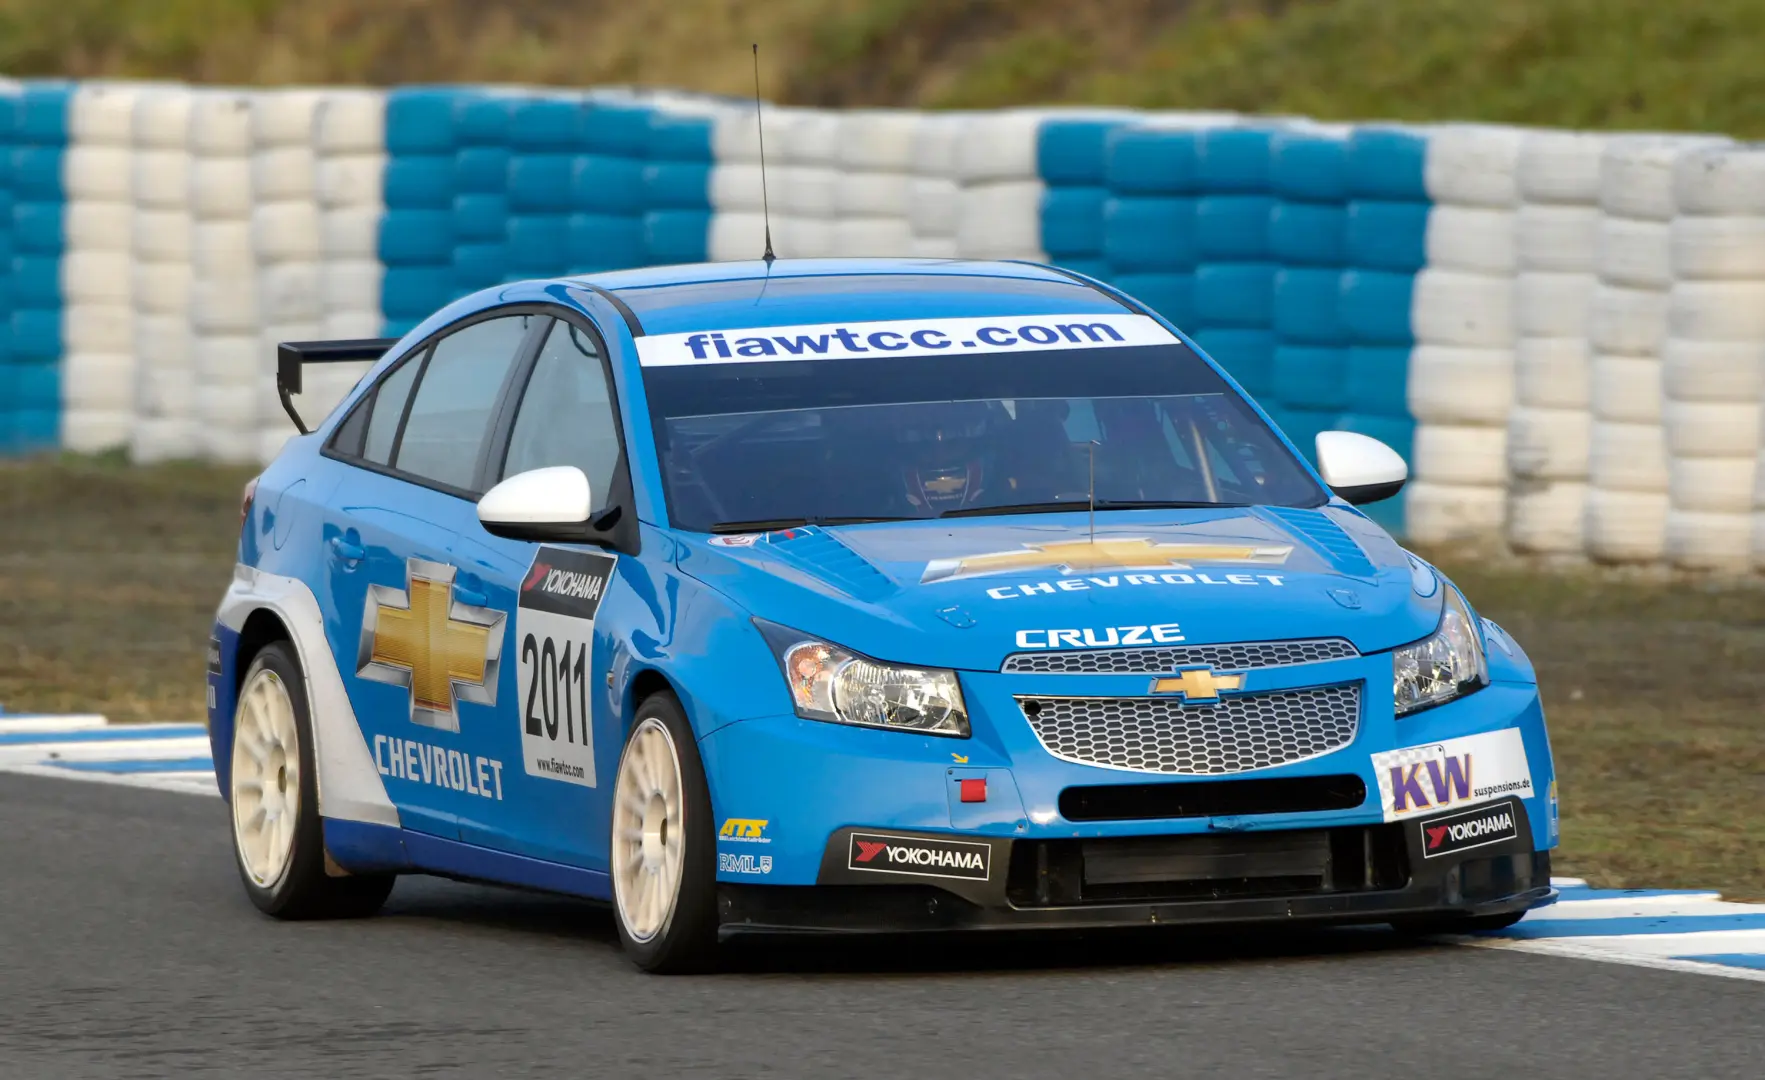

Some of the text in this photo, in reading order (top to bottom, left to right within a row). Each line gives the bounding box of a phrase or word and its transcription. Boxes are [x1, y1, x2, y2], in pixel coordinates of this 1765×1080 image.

[684, 323, 1125, 360] fiawtcc.com
[542, 568, 602, 600] YOKOHAMA
[986, 573, 1284, 600] CHEVROLET
[1016, 623, 1185, 648] CRUZE
[522, 633, 588, 746] 2011
[374, 734, 503, 800] CHEVROLET
[536, 757, 584, 778] www.fiawtcc.com
[1389, 753, 1531, 814] KW suspensions.de
[719, 818, 768, 837] ATS
[1448, 812, 1513, 841] YOKOHAMA
[719, 853, 761, 874] RML
[886, 846, 984, 870] YOKOHAMA
